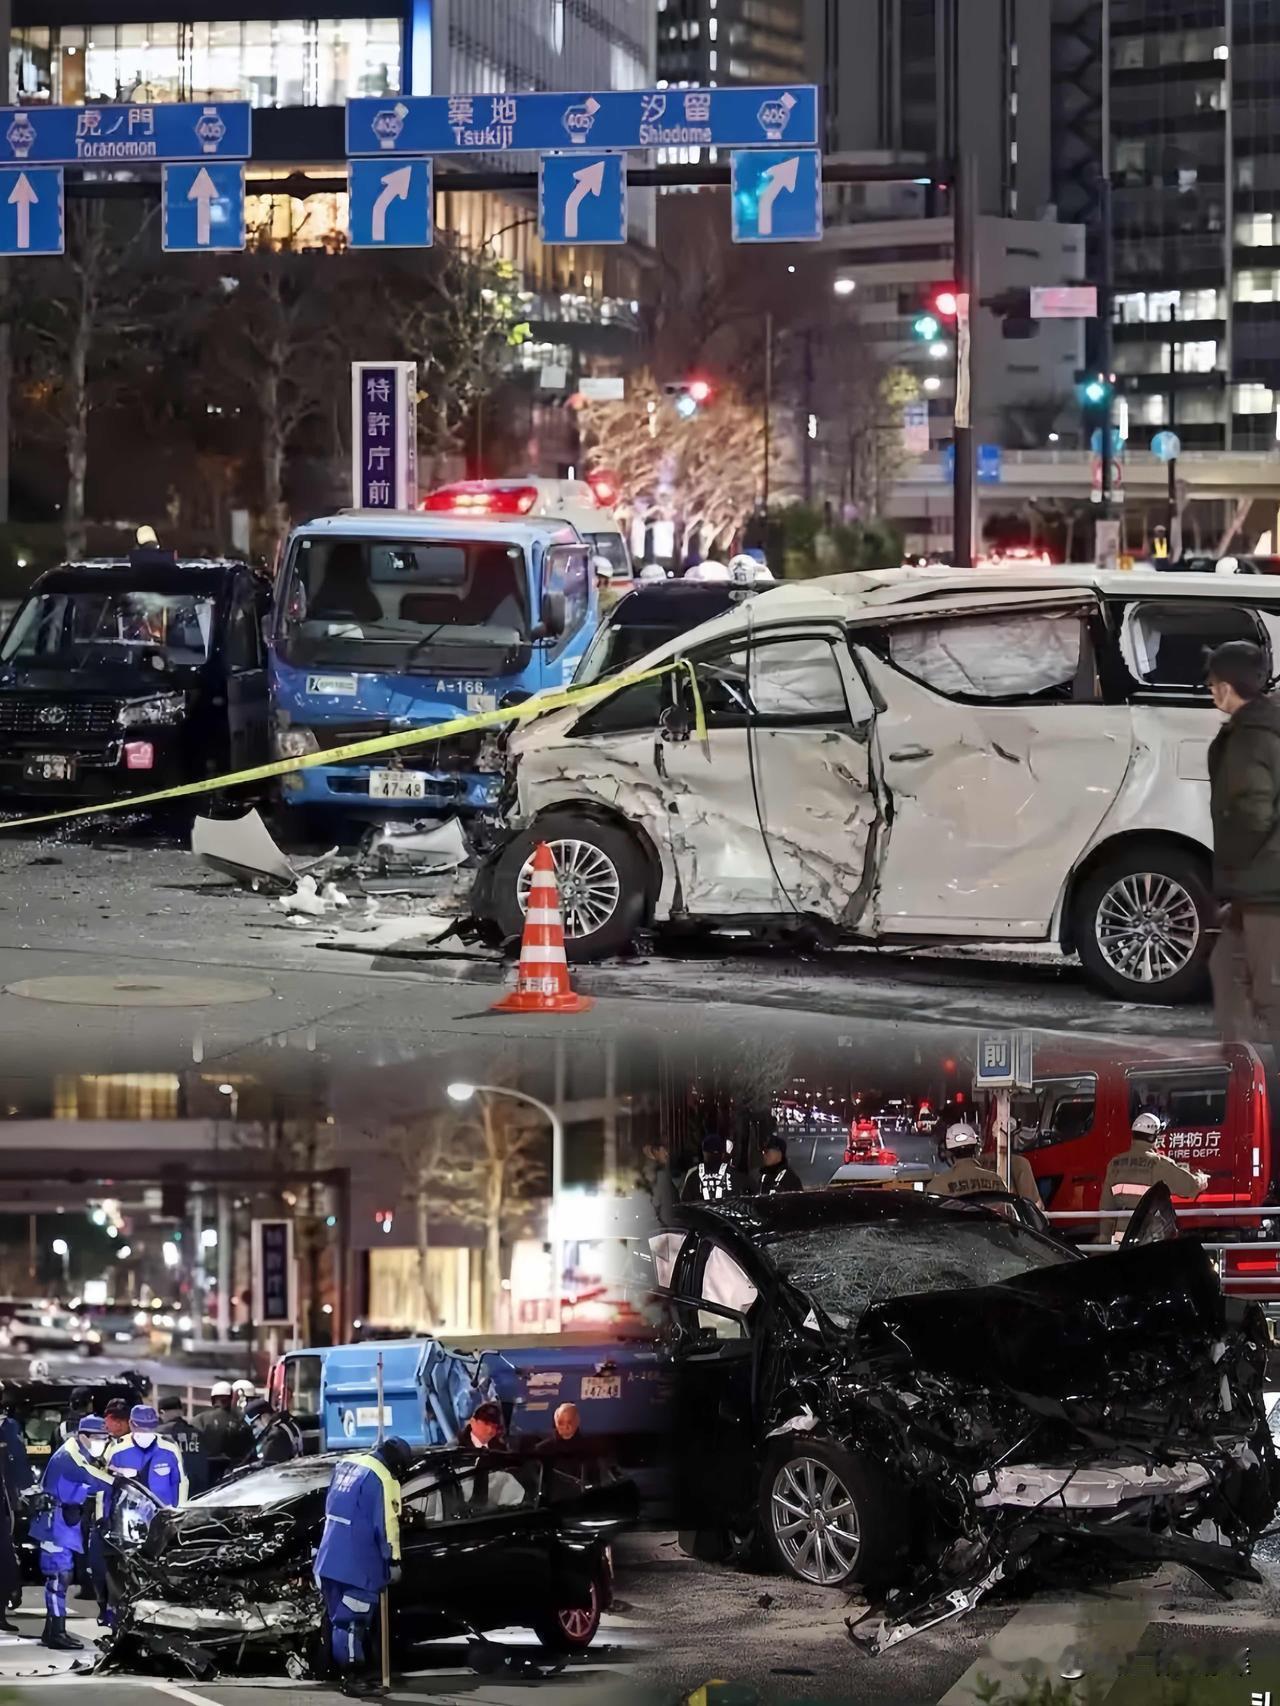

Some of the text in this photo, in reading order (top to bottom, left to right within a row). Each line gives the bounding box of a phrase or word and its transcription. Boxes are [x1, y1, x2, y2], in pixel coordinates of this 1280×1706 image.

[448, 96, 516, 125] 築地
[640, 93, 711, 122] 汐留
[75, 108, 154, 136] 虎ノ門
[452, 126, 513, 149] Tsukiji
[639, 124, 712, 144] Shiodome
[75, 138, 156, 158] Toranomon
[367, 377, 391, 505] 特許庁前
[436, 680, 484, 694] A-166
[382, 782, 422, 798] 47-48
[983, 1034, 1008, 1068] 前
[1155, 1131, 1221, 1149] 京消防庁
[1168, 1149, 1191, 1159] FIRE
[1192, 1148, 1221, 1158] DEPT.
